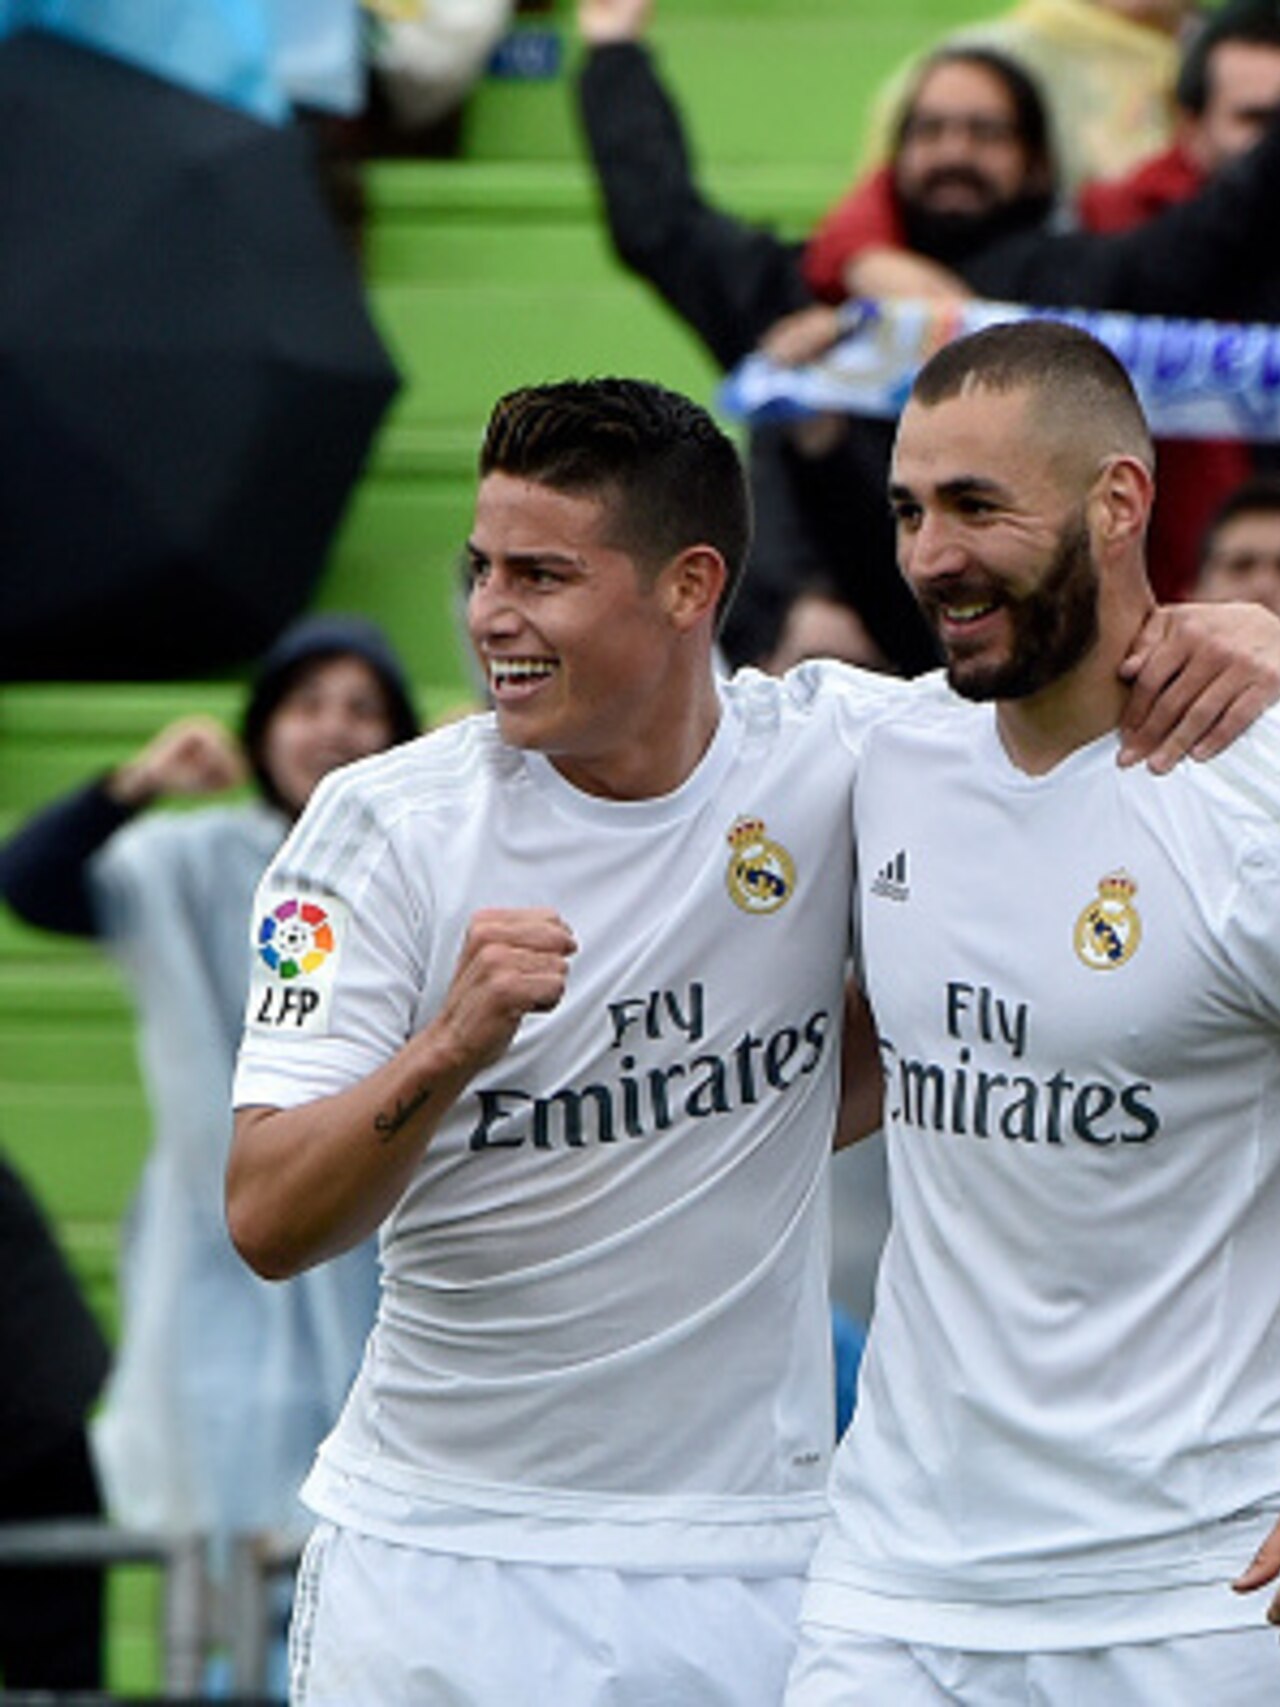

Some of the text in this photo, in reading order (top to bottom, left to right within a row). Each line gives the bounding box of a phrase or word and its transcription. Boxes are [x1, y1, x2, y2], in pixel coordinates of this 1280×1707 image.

[256, 986, 320, 1027] LFP
[607, 982, 704, 1049] Fly
[946, 981, 1028, 1058] Fly
[469, 1010, 829, 1151] Emirates
